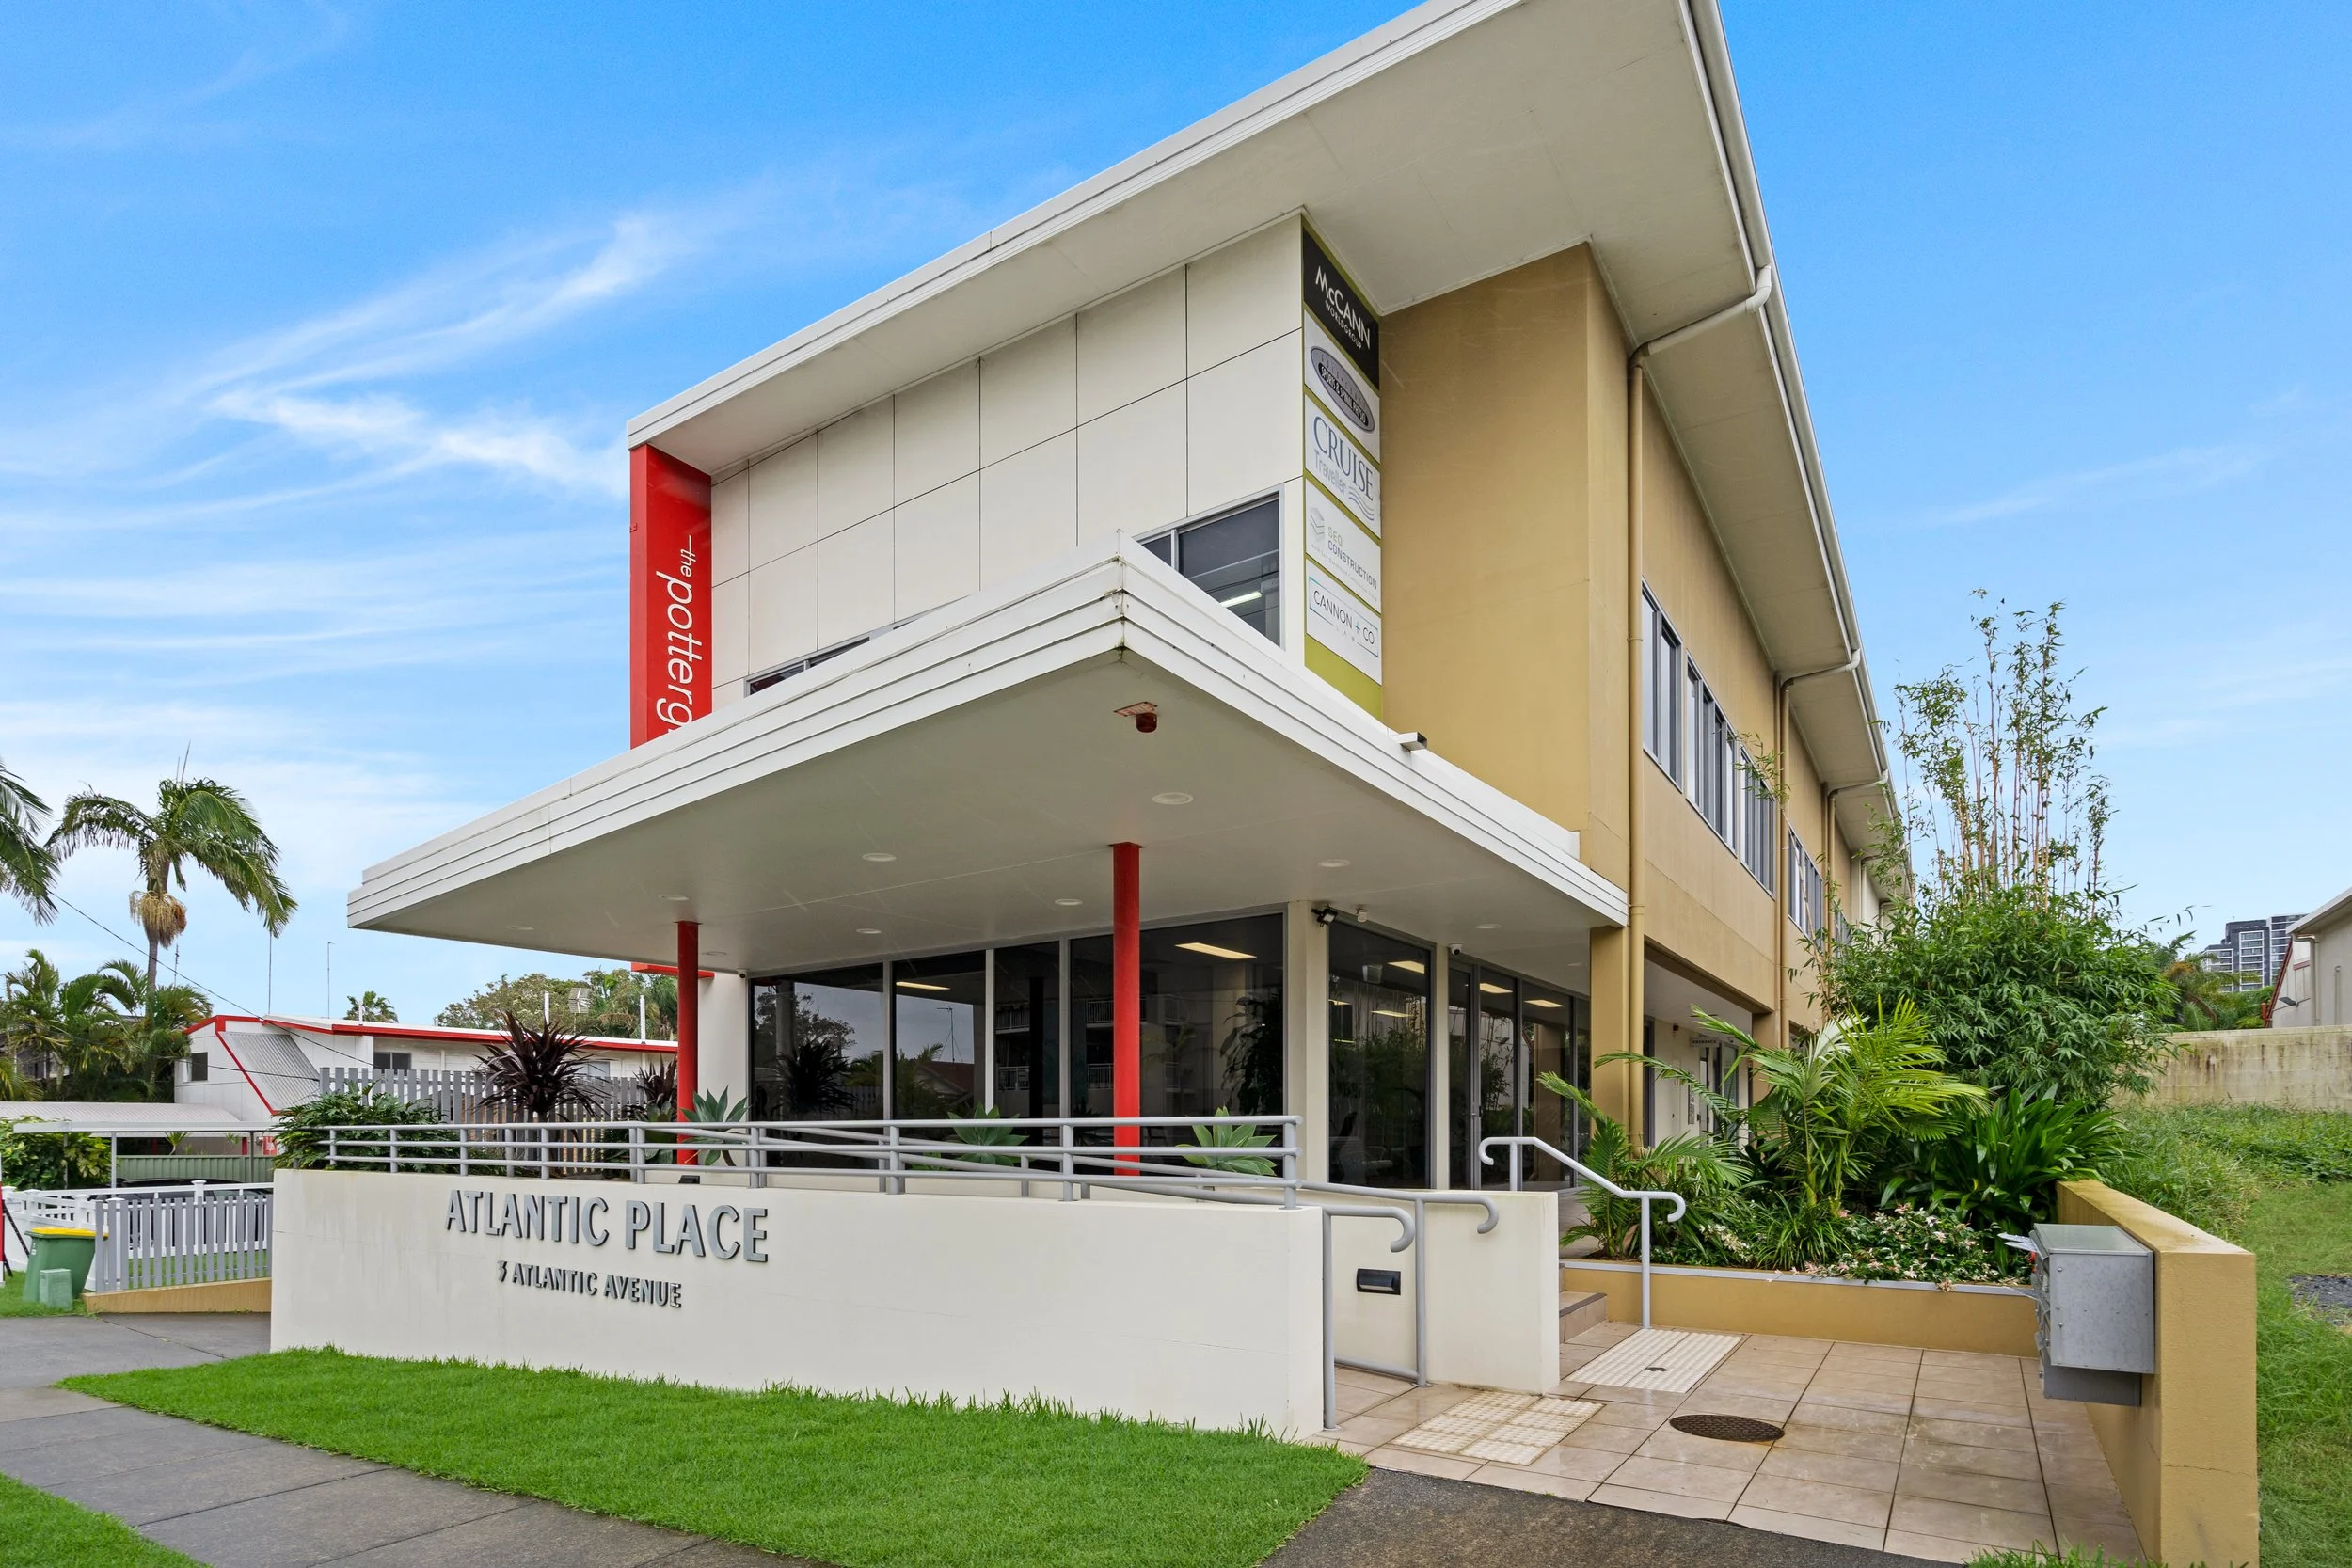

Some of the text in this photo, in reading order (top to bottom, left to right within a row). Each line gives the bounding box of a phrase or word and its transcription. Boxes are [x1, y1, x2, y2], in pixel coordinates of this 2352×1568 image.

[1315, 265, 1370, 349] McCANN
[1325, 300, 1362, 349] WORLDGROUP
[1313, 416, 1374, 501] CRUISE
[1314, 448, 1346, 496] Traveller
[680, 534, 696, 577] the
[1327, 540, 1377, 590] CONSTRUCTION
[1313, 590, 1353, 629] CANNON
[1362, 627, 1375, 645] CO
[656, 570, 702, 733] potterg
[446, 1189, 769, 1263] ATLANTIC PLACE
[512, 1262, 598, 1297] ATLANTIC
[603, 1275, 682, 1308] AVENUE
